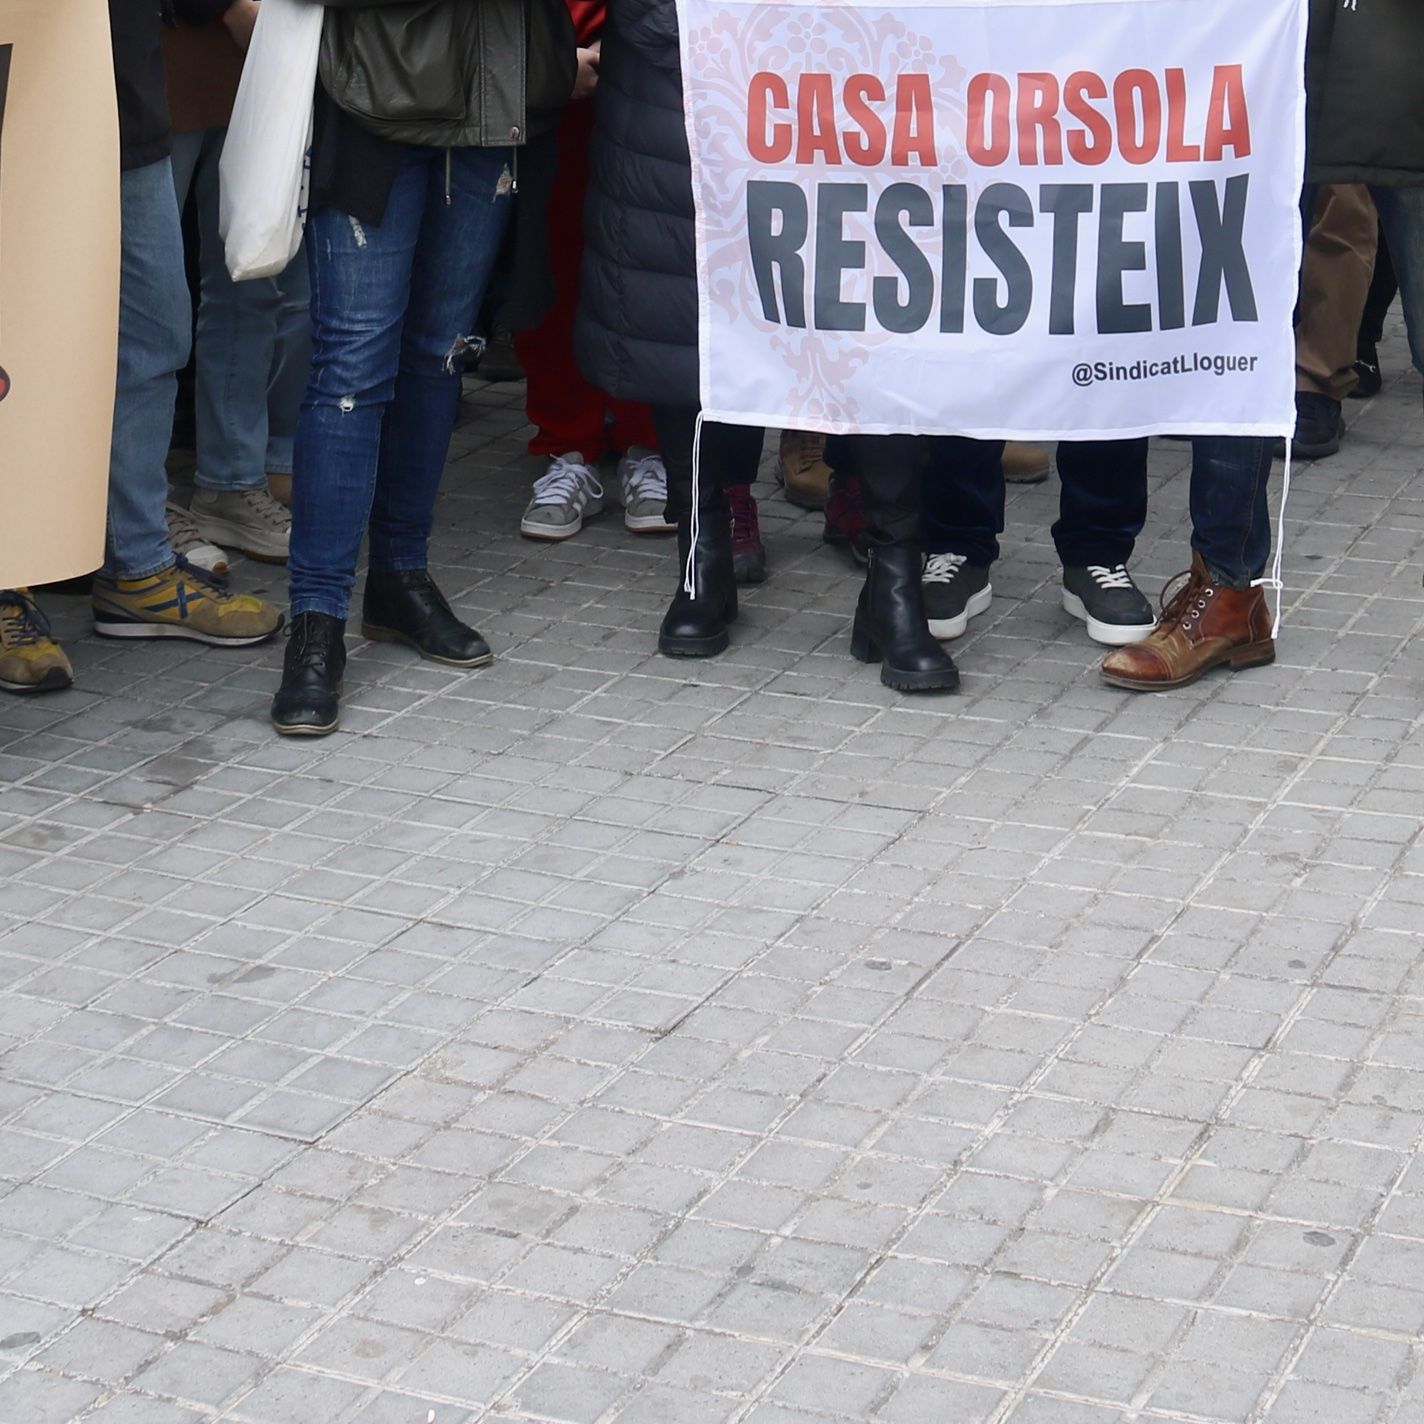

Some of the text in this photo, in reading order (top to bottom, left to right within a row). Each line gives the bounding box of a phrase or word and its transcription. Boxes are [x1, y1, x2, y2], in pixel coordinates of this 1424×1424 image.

[746, 64, 1252, 167] CASA ORSOLA
[746, 173, 1259, 336] RESISTEIX
[1071, 352, 1259, 388] @SindicatLloguer
